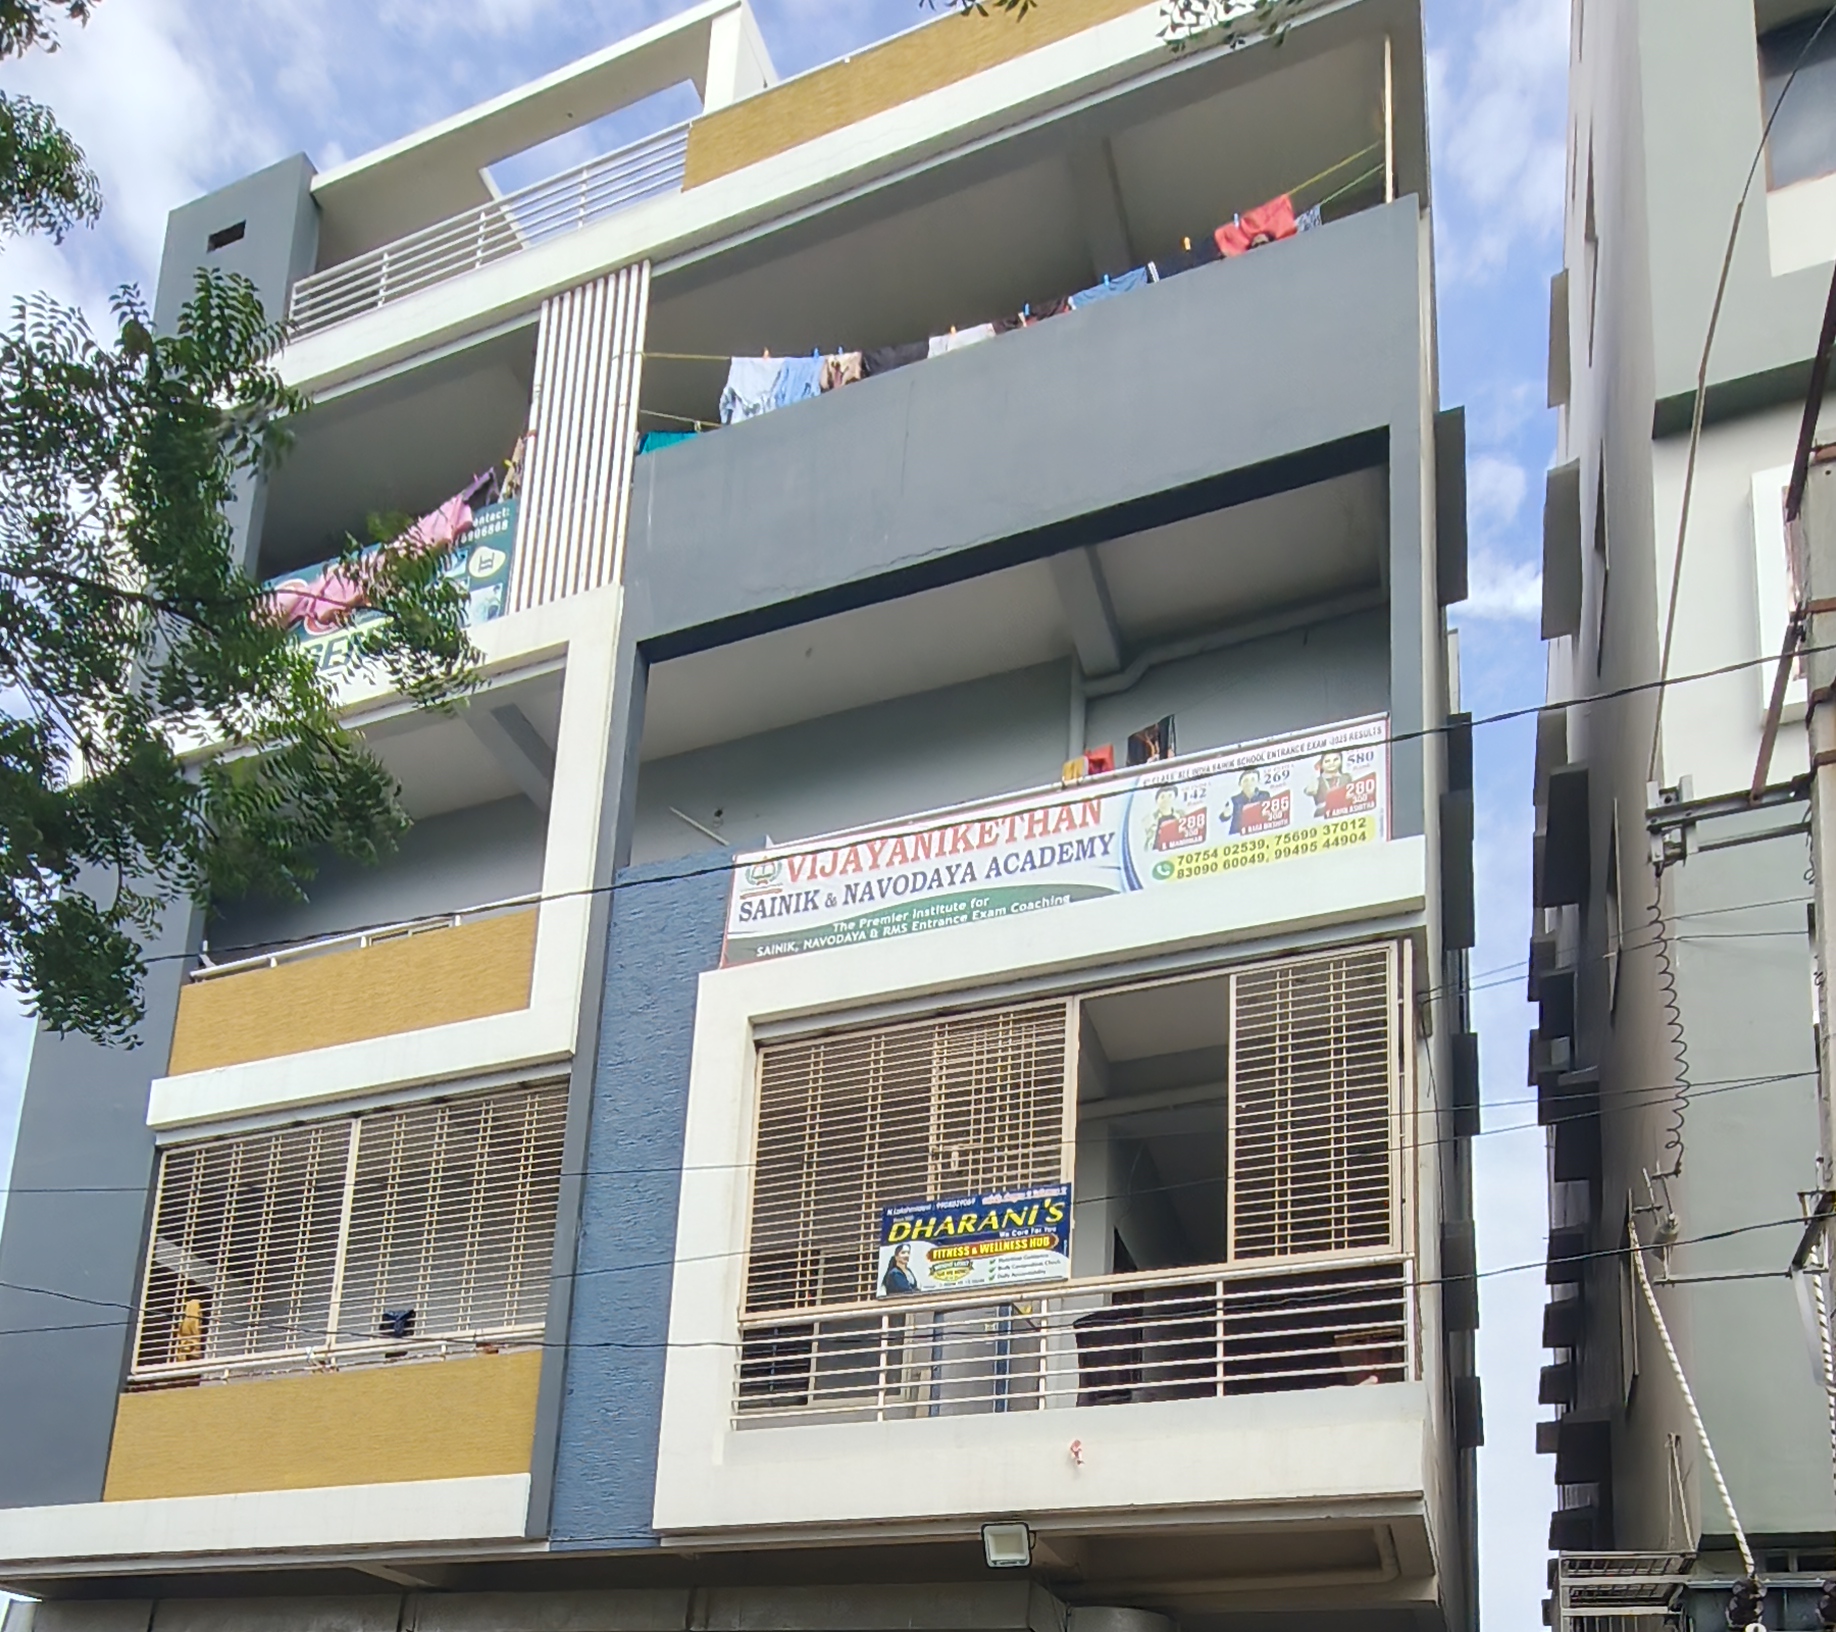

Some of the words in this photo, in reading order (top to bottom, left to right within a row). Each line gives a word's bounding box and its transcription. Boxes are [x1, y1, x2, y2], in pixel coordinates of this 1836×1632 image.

[472, 508, 510, 527] ontact:
[1237, 753, 1265, 766] SCHOOL
[1267, 744, 1306, 760] ENTRANCE
[1349, 726, 1382, 742] RESULTS
[1347, 751, 1375, 765] 580
[1264, 770, 1290, 784] 269
[1346, 779, 1375, 798] 280
[788, 799, 1101, 883] VIJAYANIKETHAN
[1176, 862, 1218, 880] 83090
[1321, 831, 1367, 850] 44904
[1177, 849, 1219, 867] 70754
[1275, 828, 1318, 845] 75699
[1322, 817, 1367, 836] 37012
[739, 889, 820, 922] SAINIK
[825, 892, 837, 908] &
[842, 861, 977, 906] NAVODAYA
[985, 832, 1115, 879] ACADEMY
[757, 941, 799, 958] SAINIK,
[803, 930, 866, 950] NAVODAYA
[870, 928, 878, 939] &
[883, 922, 907, 936] RMS
[911, 913, 967, 931] Entrance
[972, 907, 1007, 920] Exam
[1011, 893, 1072, 914] Coaching
[833, 921, 857, 932] The
[859, 911, 908, 929] Premier
[913, 901, 967, 919] Institute
[970, 896, 990, 908] for
[888, 1198, 1065, 1242] DHARANI'S
[932, 1245, 970, 1259] FITNESS
[980, 1238, 1028, 1254] WELLNESS
[1030, 1236, 1050, 1248] HUB
